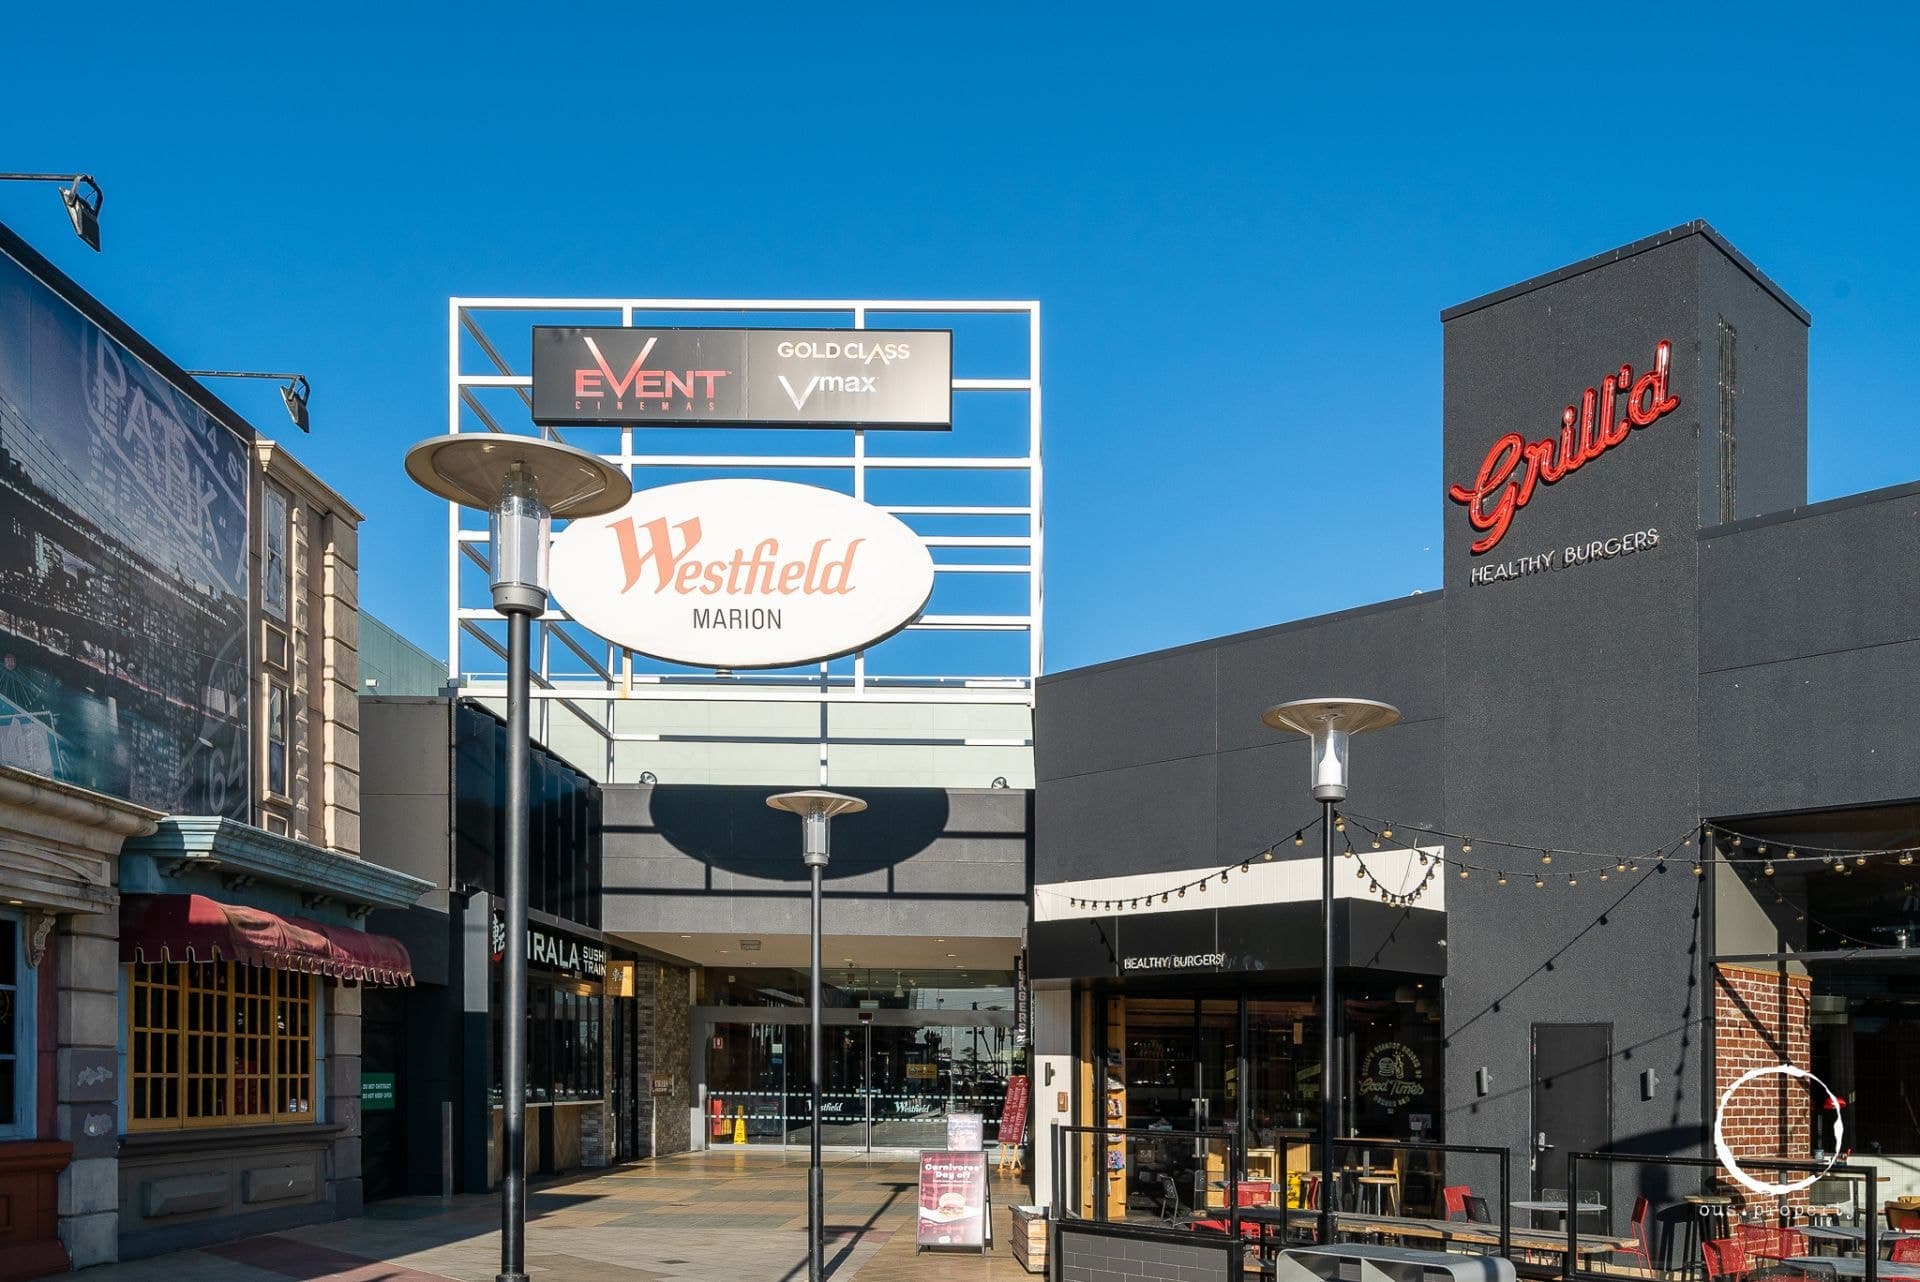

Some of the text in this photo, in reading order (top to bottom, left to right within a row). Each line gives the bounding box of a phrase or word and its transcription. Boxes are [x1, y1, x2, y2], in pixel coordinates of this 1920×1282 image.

[777, 342, 910, 365] GOLD CLASS
[575, 337, 727, 399] EVENT
[778, 375, 877, 411] Vmax
[575, 402, 716, 412] CINEMAS
[1450, 339, 1680, 554] Grill'd
[605, 516, 866, 595] Westfield
[1470, 528, 1660, 583] HEALTHY BURGERS
[693, 608, 782, 630] MARION
[527, 930, 580, 970] IRALA
[583, 946, 607, 963] SUSHI
[1124, 953, 1223, 969] HEALTHY BURGERS
[583, 959, 607, 977] TRAIN
[894, 1101, 931, 1113] Westfield
